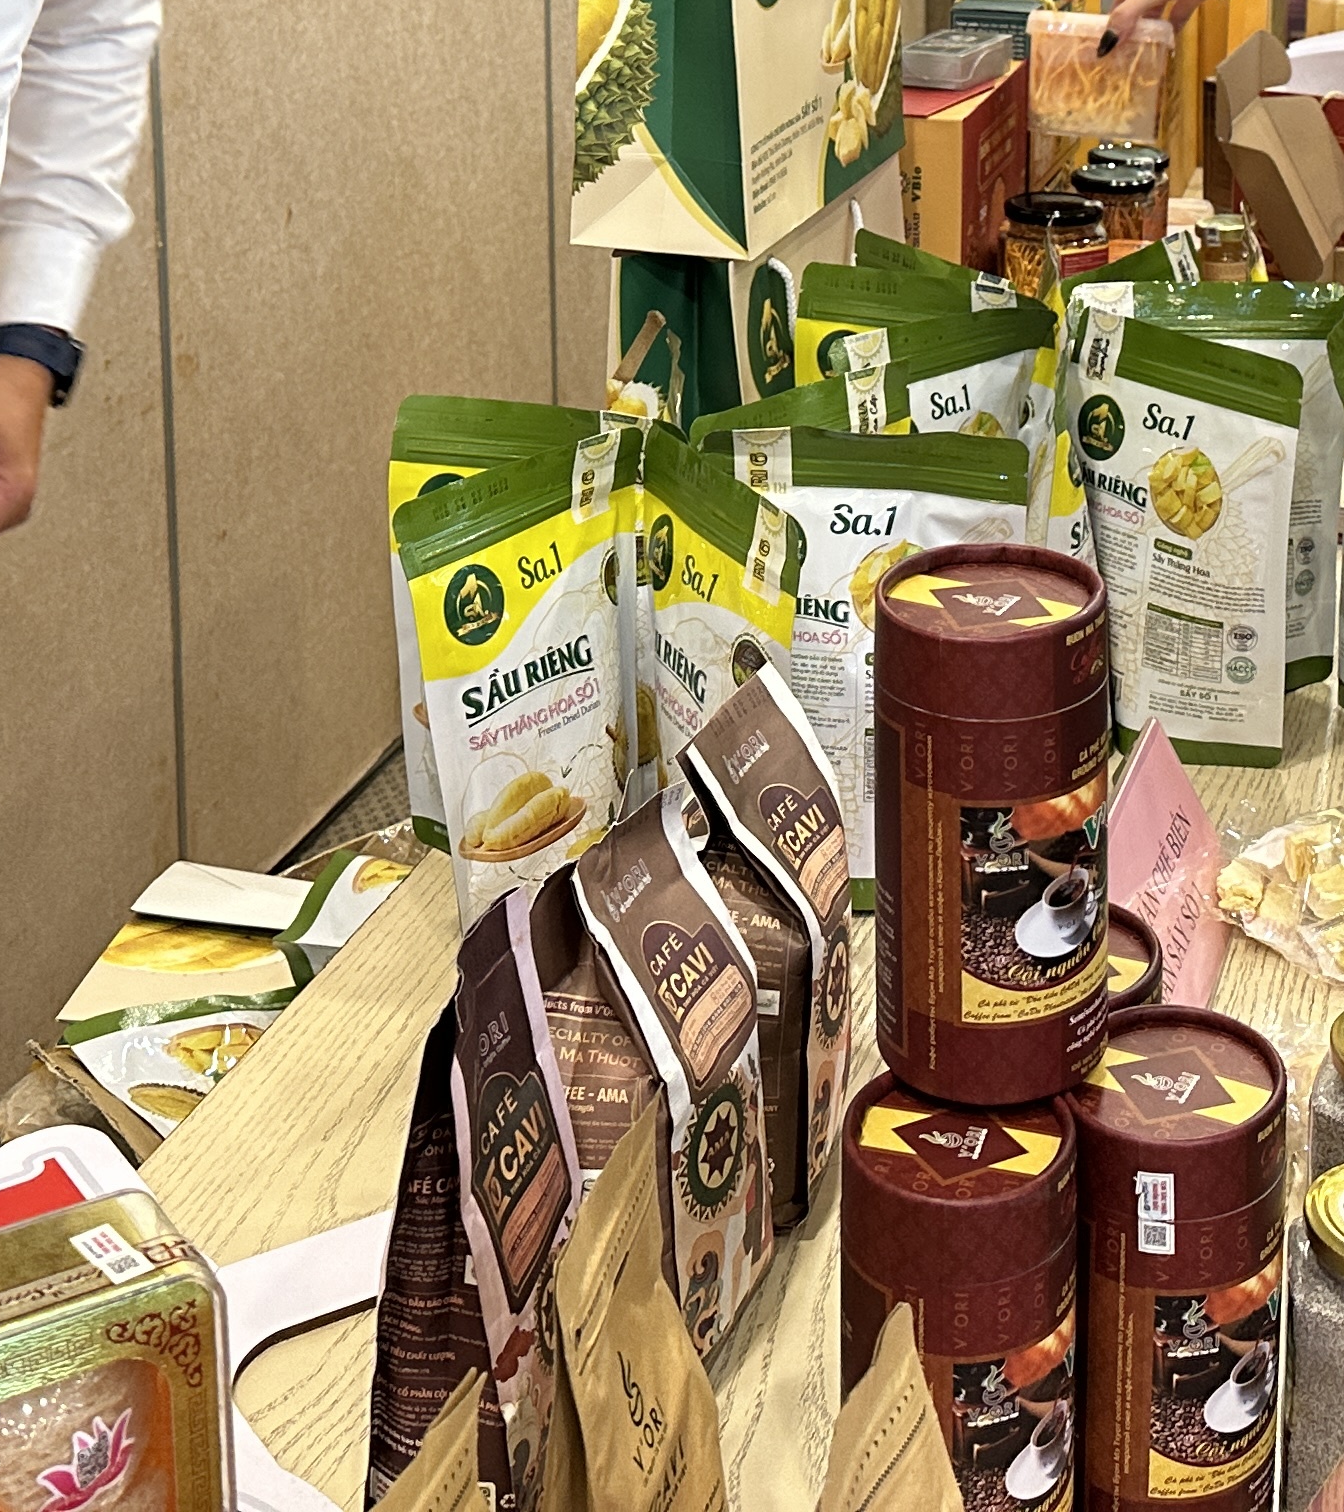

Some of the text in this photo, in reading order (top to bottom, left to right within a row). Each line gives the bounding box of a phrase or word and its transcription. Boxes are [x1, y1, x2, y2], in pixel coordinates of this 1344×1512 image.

[930, 384, 971, 421] Sa.1
[1143, 403, 1196, 441] Sa.1
[1098, 473, 1148, 508] RIÊNG
[830, 504, 898, 536] Sa.1
[518, 541, 564, 590] Sa.1
[681, 554, 720, 603] Sa.1
[1193, 566, 1211, 578] Hoa
[796, 594, 850, 624] IÊNG
[793, 631, 820, 643] HOA
[821, 629, 841, 645] SỐ
[462, 635, 594, 720] SẦU RIÊNG
[664, 640, 707, 704] RIÊNG
[469, 728, 500, 751] SẤY
[500, 709, 550, 743] THĂNG
[548, 694, 576, 721] HOA
[577, 681, 595, 705] SỐ
[562, 710, 582, 730] Dried
[960, 735, 975, 793] V'ORI
[1006, 735, 1017, 793] V'ORI
[767, 792, 799, 832] CAFÉ
[787, 804, 826, 851] CAVI
[1165, 804, 1192, 859] BIẾN
[975, 850, 1029, 867] V'ORI
[750, 913, 781, 930] AMA
[650, 931, 684, 976] CAFÉ
[669, 940, 715, 999] CAVI
[570, 1001, 593, 1014] from
[964, 1010, 991, 1021] Coffee
[992, 1010, 1011, 1021] from
[549, 1026, 609, 1044] ECIALTY
[588, 1049, 641, 1068] THUOT
[597, 1087, 628, 1104] AMA
[500, 1100, 547, 1182] CAVI
[955, 1292, 969, 1350] V'ORI
[1168, 1334, 1220, 1352] V'ORI
[968, 1401, 1020, 1419] V'ORI
[633, 1396, 667, 1473] V'ORI
[1150, 1486, 1177, 1497] Coffee
